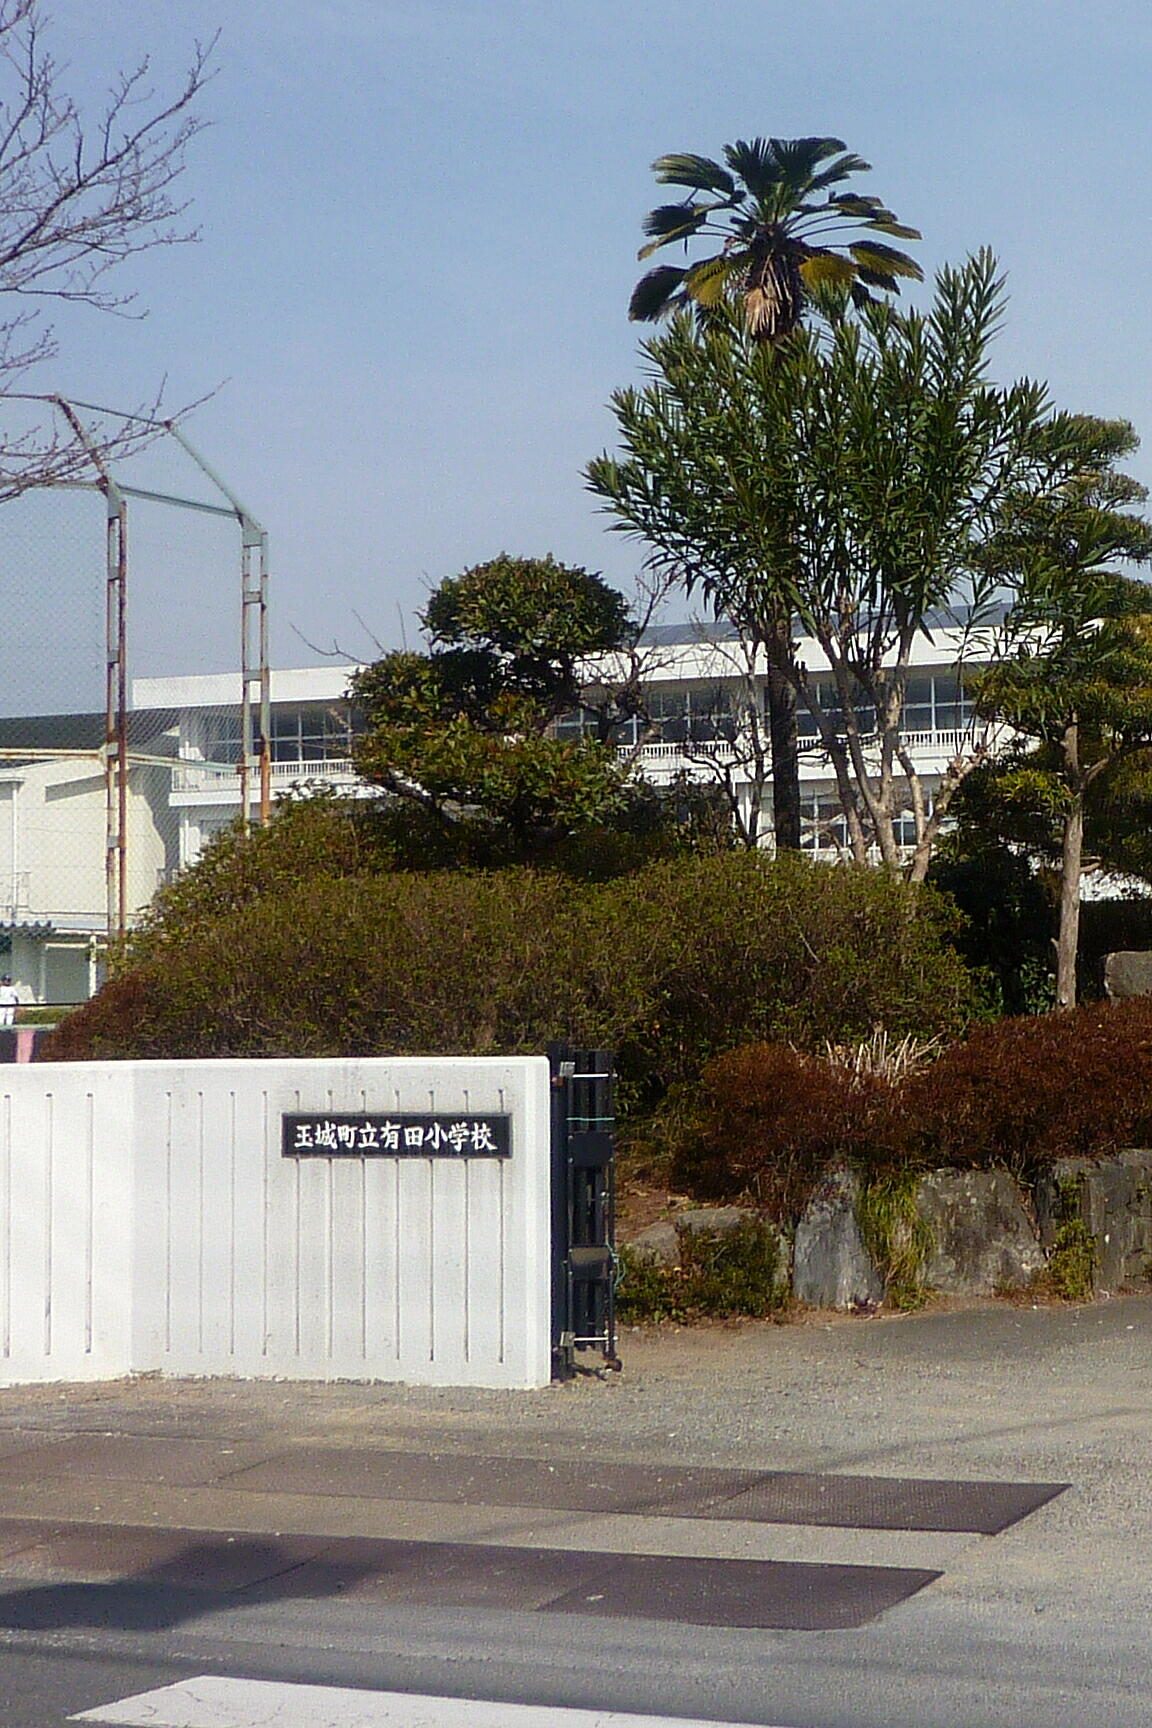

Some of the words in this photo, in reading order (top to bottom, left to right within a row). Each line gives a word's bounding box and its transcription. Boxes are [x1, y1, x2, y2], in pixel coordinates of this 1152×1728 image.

[294, 1120, 498, 1151] 玉城町立有田小学校
